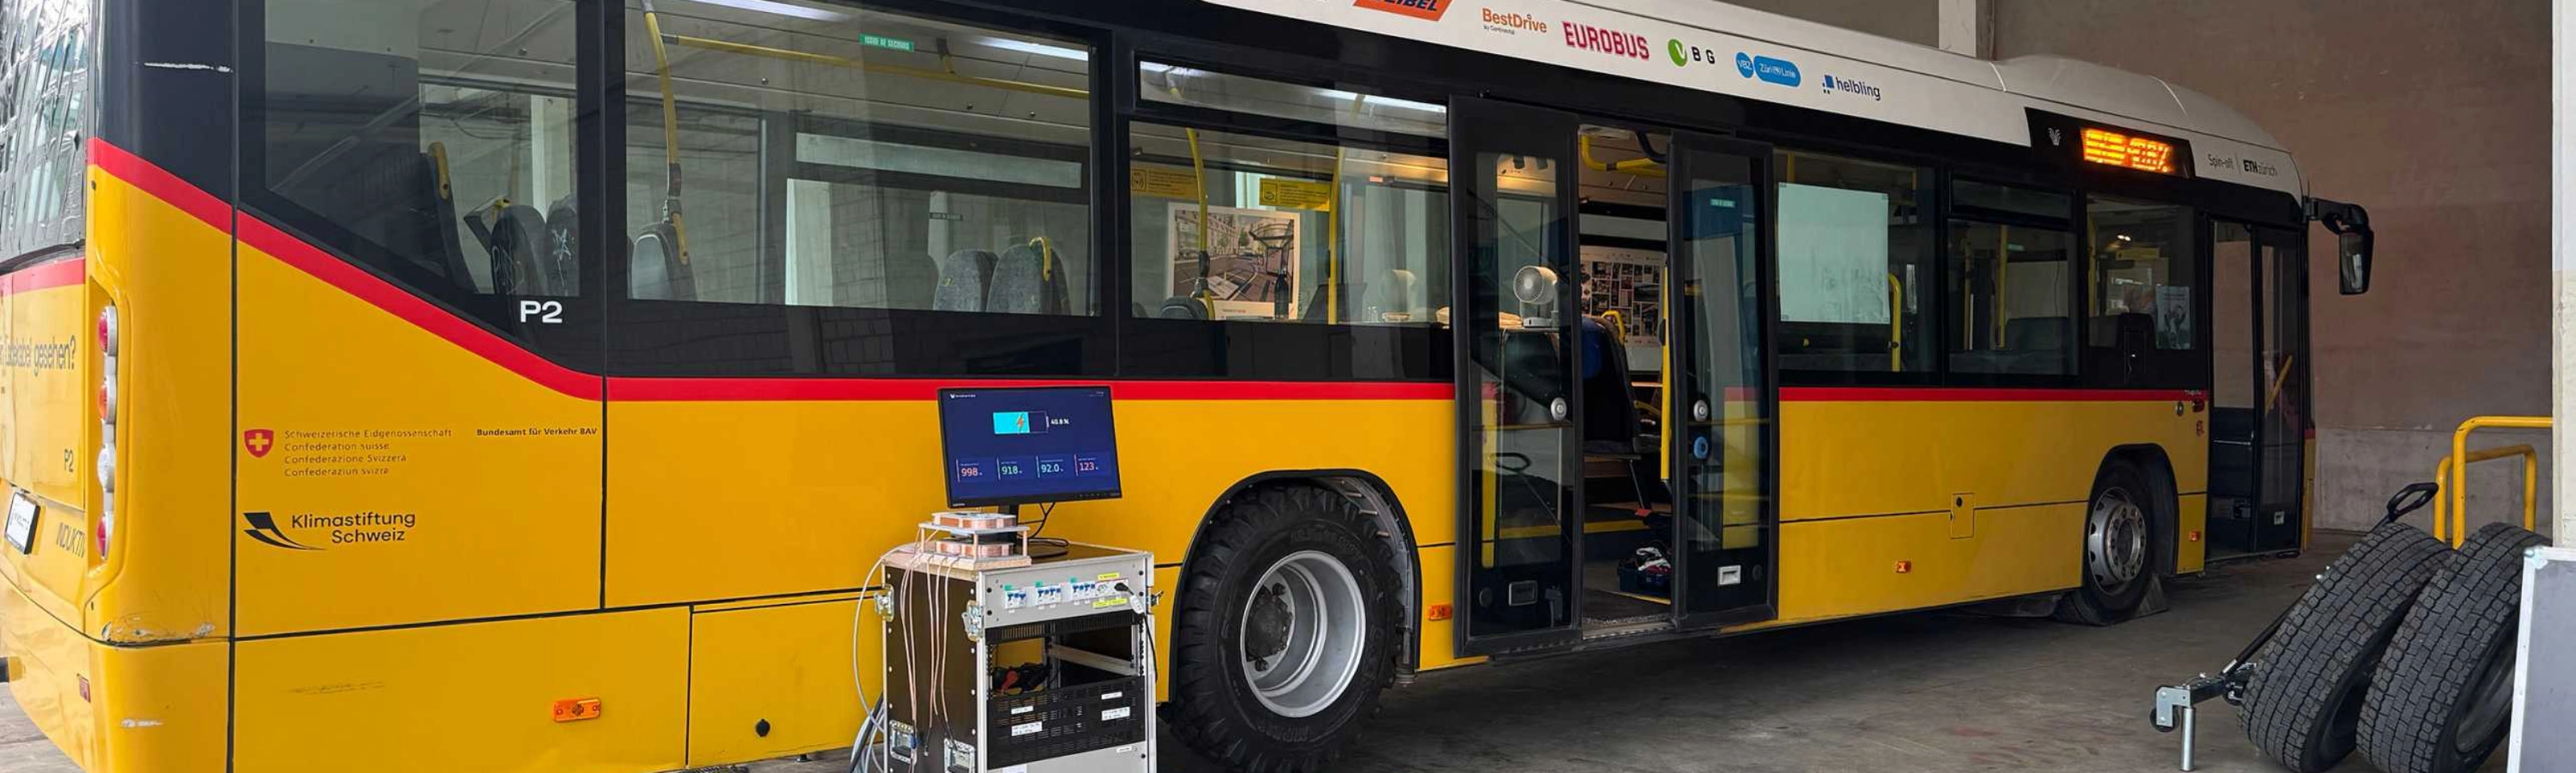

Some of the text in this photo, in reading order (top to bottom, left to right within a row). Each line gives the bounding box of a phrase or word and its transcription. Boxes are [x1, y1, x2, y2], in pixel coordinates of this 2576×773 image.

[1482, 8, 1547, 33] BestDrive
[1563, 21, 1650, 61] EUROBUS
[1835, 77, 1880, 101] helbling
[520, 300, 563, 323] P2
[34, 334, 76, 377] gesehen?
[284, 428, 452, 440] Schweizerische Eidgenossenschaft
[477, 428, 597, 436] Bundesamt für Verkehr BAV
[64, 449, 74, 473] P2
[284, 454, 407, 465] Confederazione Svizzera
[1080, 461, 1095, 472] 123
[284, 468, 358, 477] Confederaziun
[961, 467, 978, 477] 998
[1001, 465, 1018, 475] 918
[1041, 464, 1059, 473] 92.0
[291, 511, 416, 529] Klimastiftung
[331, 528, 406, 544] Schweiz
